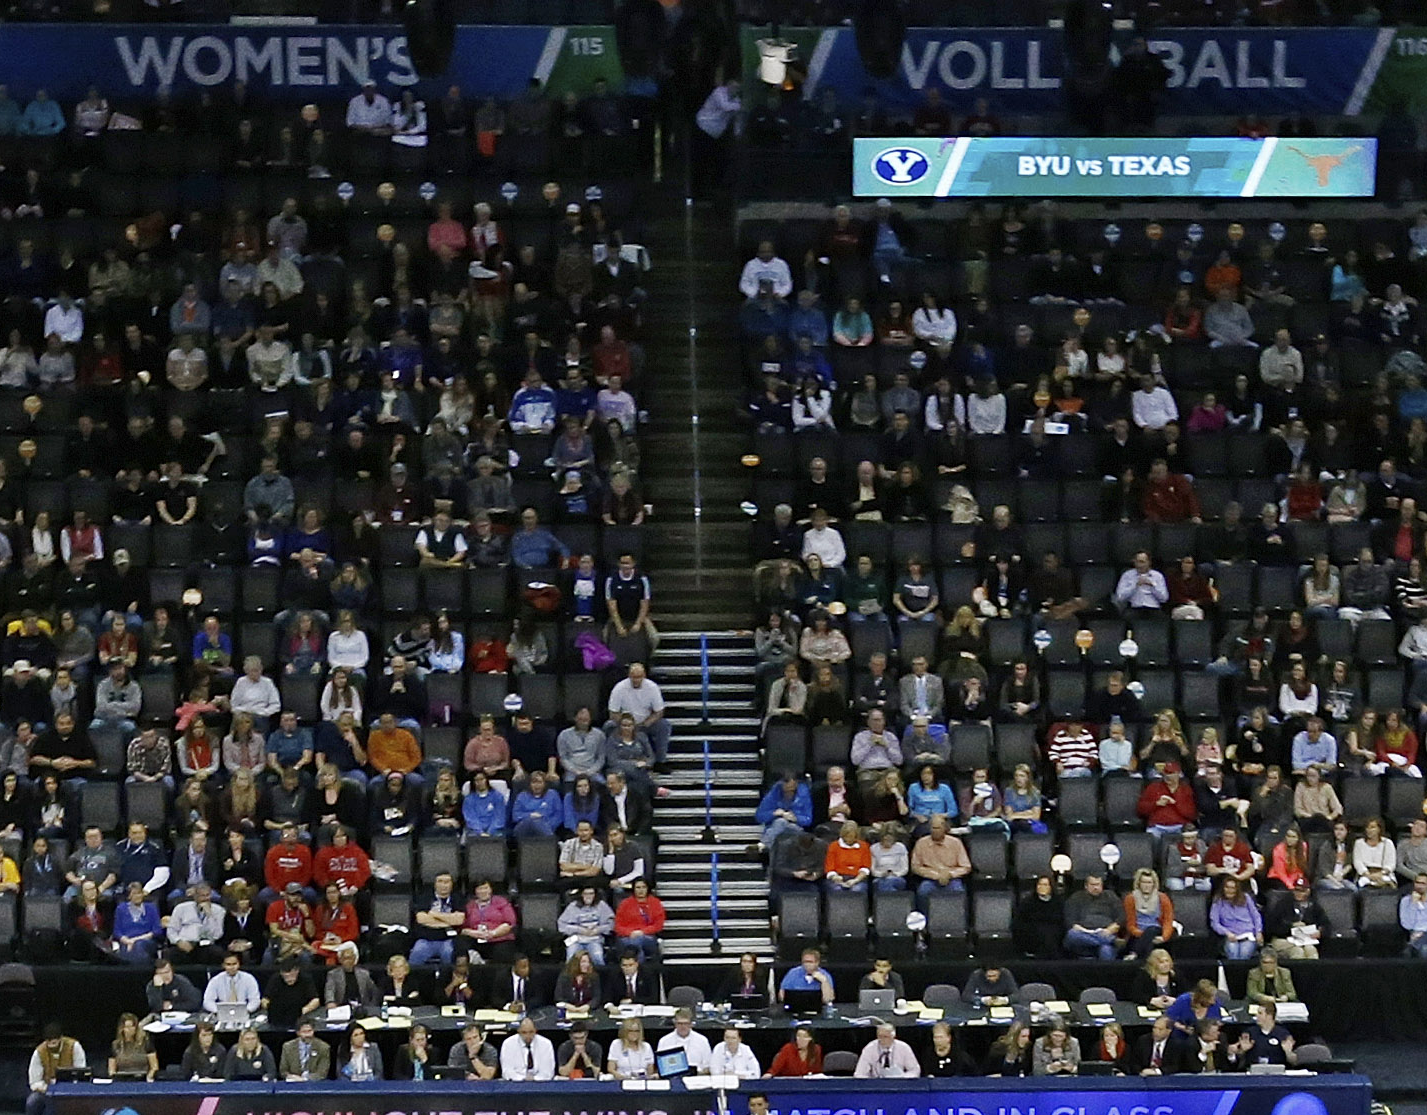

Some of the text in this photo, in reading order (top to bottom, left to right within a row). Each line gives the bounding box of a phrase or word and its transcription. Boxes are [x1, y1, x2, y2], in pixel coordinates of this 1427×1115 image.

[114, 35, 421, 87] WOMEN'S
[569, 37, 605, 56] 115
[901, 39, 1307, 90] VOLLBALL
[1018, 155, 1191, 177] BYU vs TEXAS
